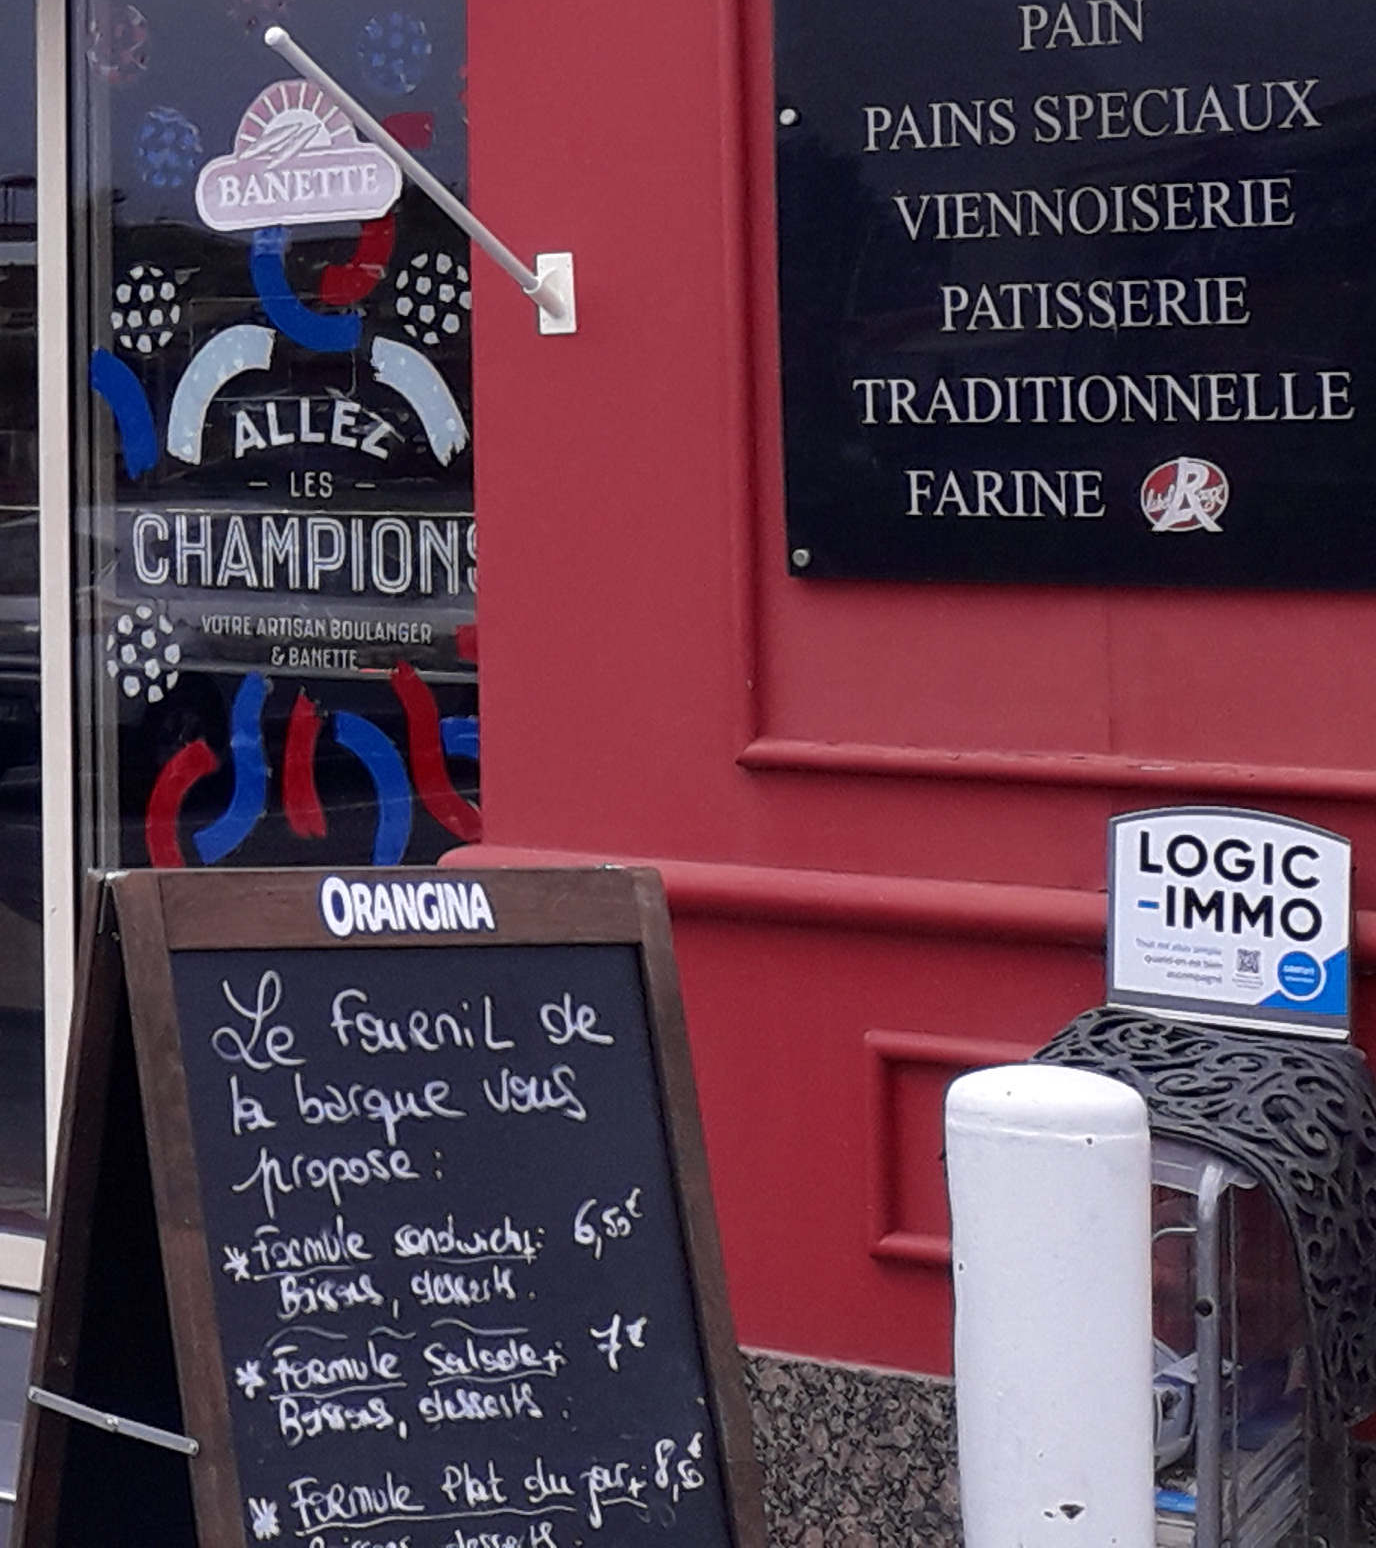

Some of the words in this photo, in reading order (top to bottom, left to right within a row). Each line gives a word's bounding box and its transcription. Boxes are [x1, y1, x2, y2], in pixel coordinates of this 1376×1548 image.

[861, 97, 1017, 152] PAINS
[1032, 79, 1323, 145] SPECIAUX
[217, 162, 380, 208] BANETTE
[893, 177, 1296, 241] VIENNOISERIE
[940, 276, 1251, 332] PATISSERIE
[852, 371, 1357, 425] TRADITIONNELLE
[234, 397, 390, 458] ALLEZ
[289, 470, 333, 499] LES
[903, 470, 1106, 518] FARINE
[201, 614, 252, 636] VOTRE
[256, 616, 327, 639] ARTISAN
[331, 618, 432, 644] BOULANGER
[270, 646, 285, 666] &
[289, 647, 358, 669] BANETTE
[1140, 830, 1321, 889] LOGIC
[211, 969, 307, 1071] Le
[539, 992, 615, 1047] de
[229, 1074, 277, 1137] la
[295, 1072, 468, 1147] barque
[483, 1063, 588, 1123] vous
[439, 1459, 509, 1508] Plat
[523, 1456, 576, 1503] du
